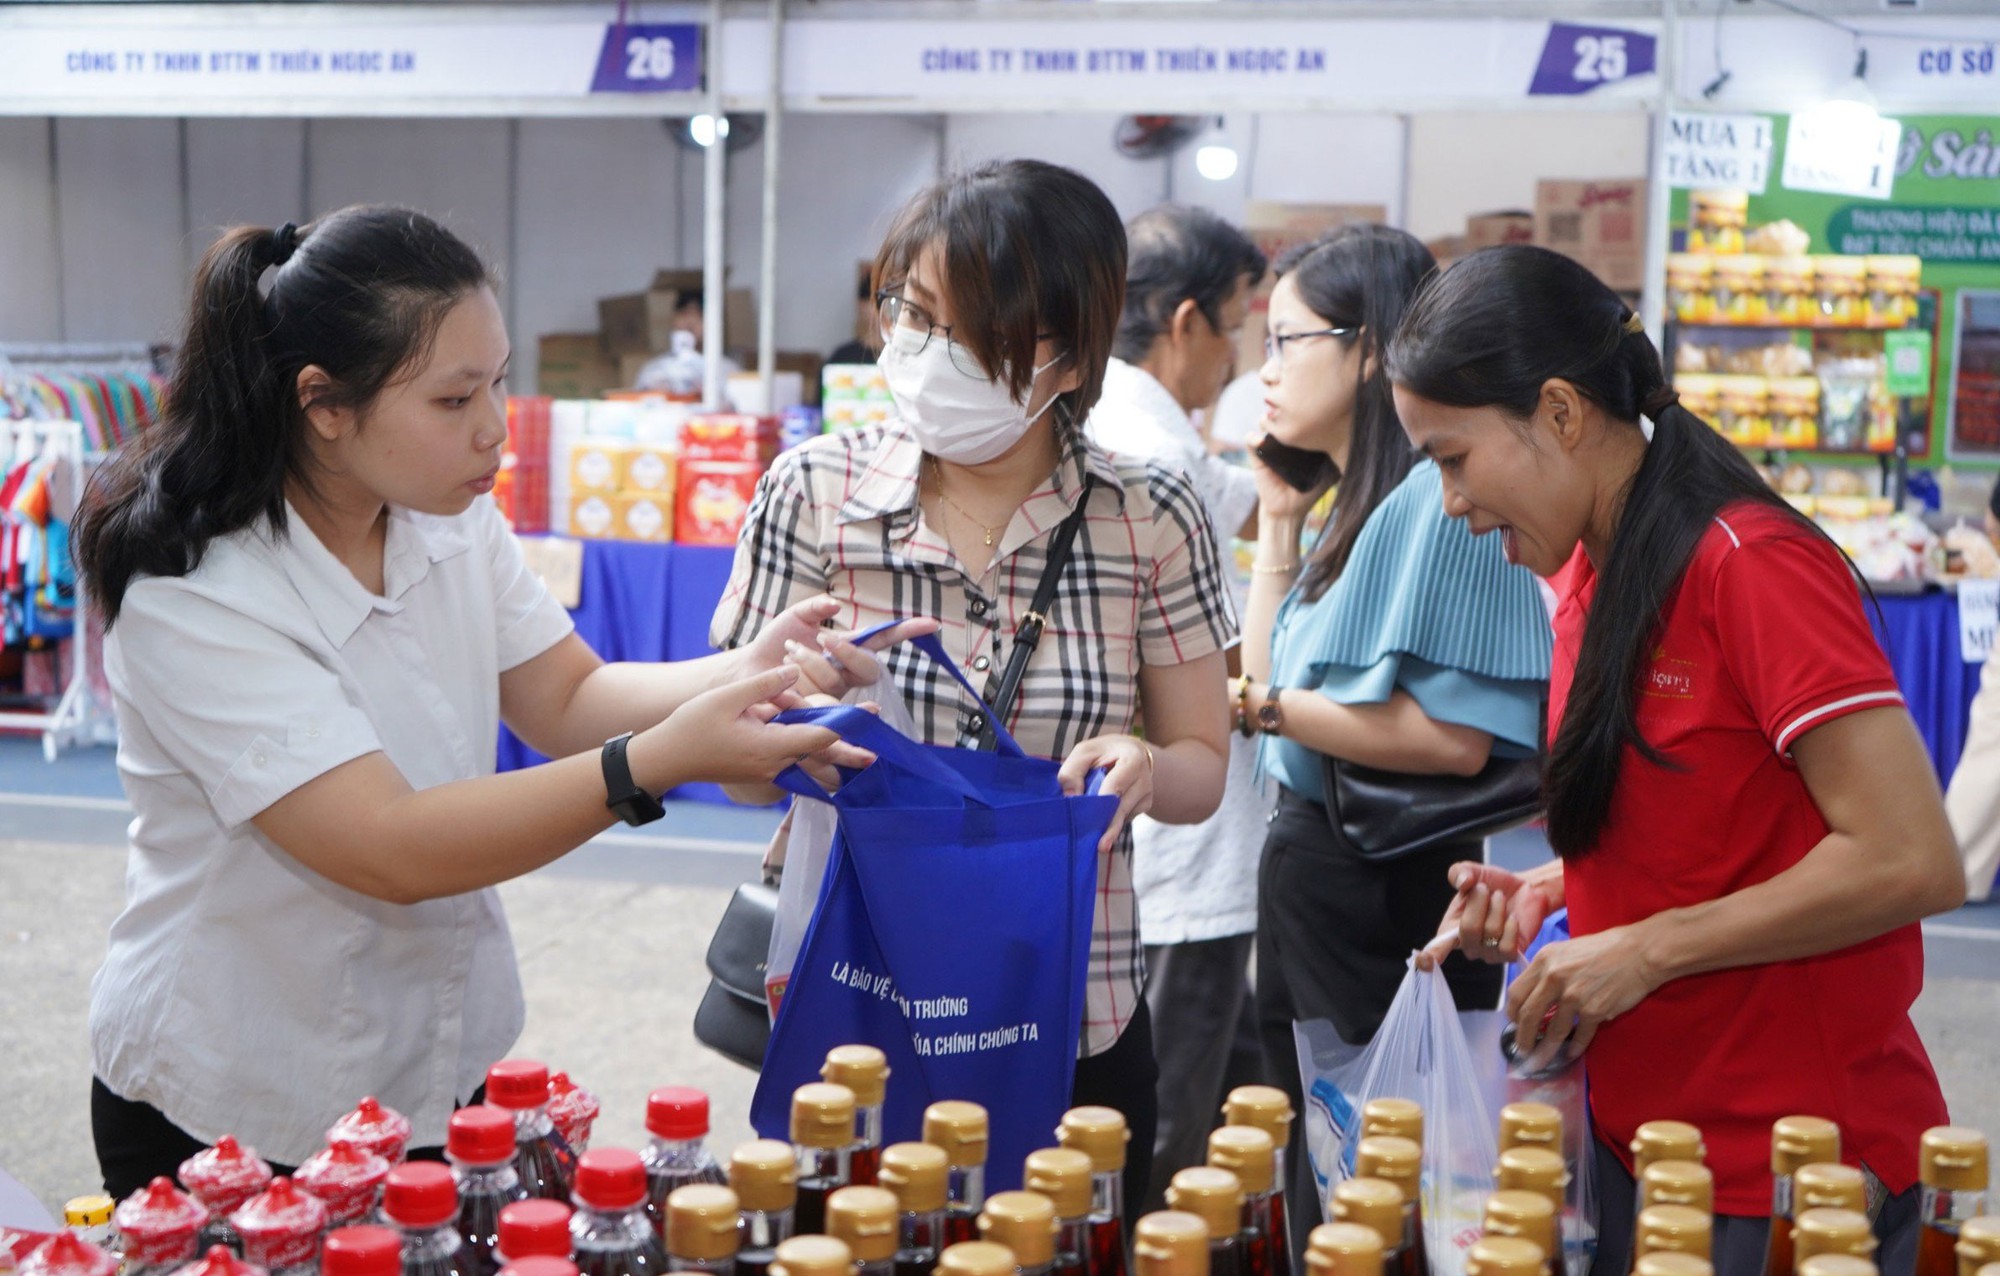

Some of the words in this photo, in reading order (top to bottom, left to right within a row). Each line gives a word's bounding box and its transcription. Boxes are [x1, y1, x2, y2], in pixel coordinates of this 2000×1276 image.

[125, 51, 144, 73] TY
[154, 51, 202, 73] TNHH
[626, 36, 675, 80] 26
[923, 45, 980, 73] CÔNG
[989, 49, 1012, 73] TY
[1022, 49, 1078, 73] TNHH
[1573, 36, 1628, 80] 25
[1919, 45, 1954, 74] CƠ
[1962, 40, 1995, 74] SỞ
[1669, 117, 1737, 148] MUA
[1754, 125, 1764, 150] 1
[831, 961, 850, 984] LÀ
[849, 965, 872, 991] BẢO
[872, 975, 892, 1000] VỆ
[913, 995, 968, 1019] TRƯỜNG
[934, 1031, 976, 1056] CHÍNH
[979, 1025, 1019, 1051] CHÚNG
[1021, 1022, 1039, 1041] TA
